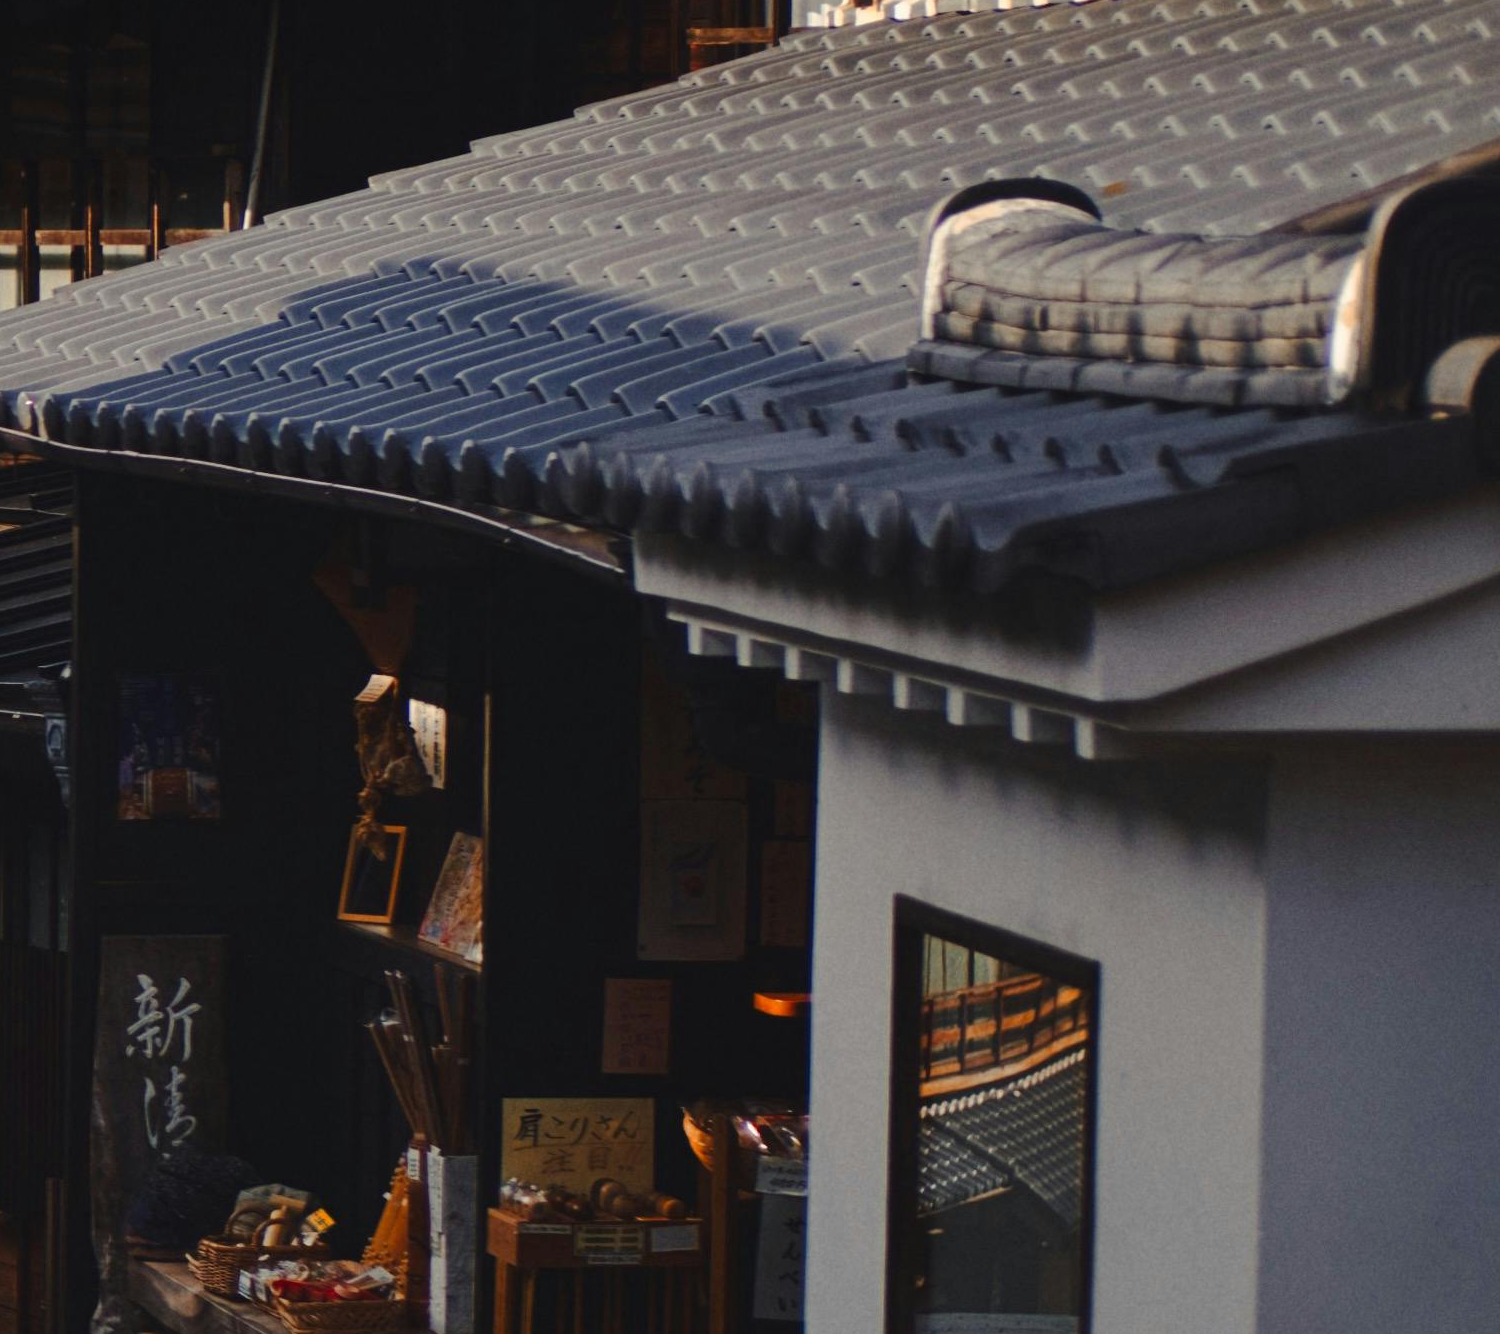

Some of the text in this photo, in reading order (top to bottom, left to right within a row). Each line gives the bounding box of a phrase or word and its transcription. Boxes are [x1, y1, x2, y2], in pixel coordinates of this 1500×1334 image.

[124, 972, 204, 1160] 新清
[514, 1108, 637, 1146] 肩こりさん
